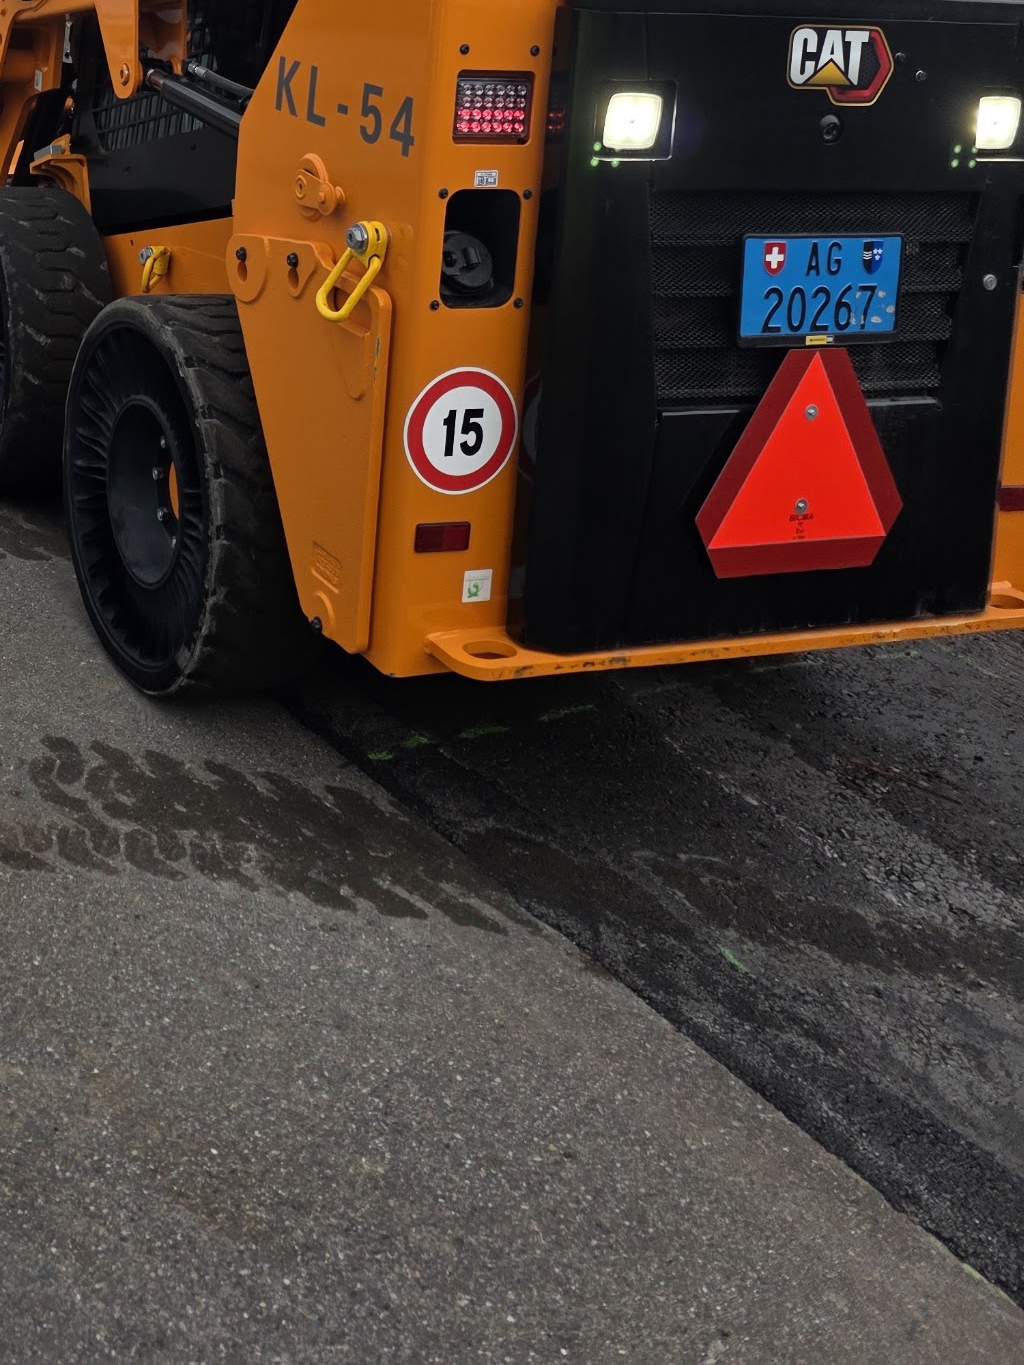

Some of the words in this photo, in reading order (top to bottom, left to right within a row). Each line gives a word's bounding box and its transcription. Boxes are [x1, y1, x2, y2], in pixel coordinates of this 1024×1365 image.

[790, 28, 870, 86] CAT
[275, 56, 416, 159] KL-54
[805, 240, 843, 277] AG
[761, 283, 878, 334] 20267
[442, 408, 485, 457] 15
